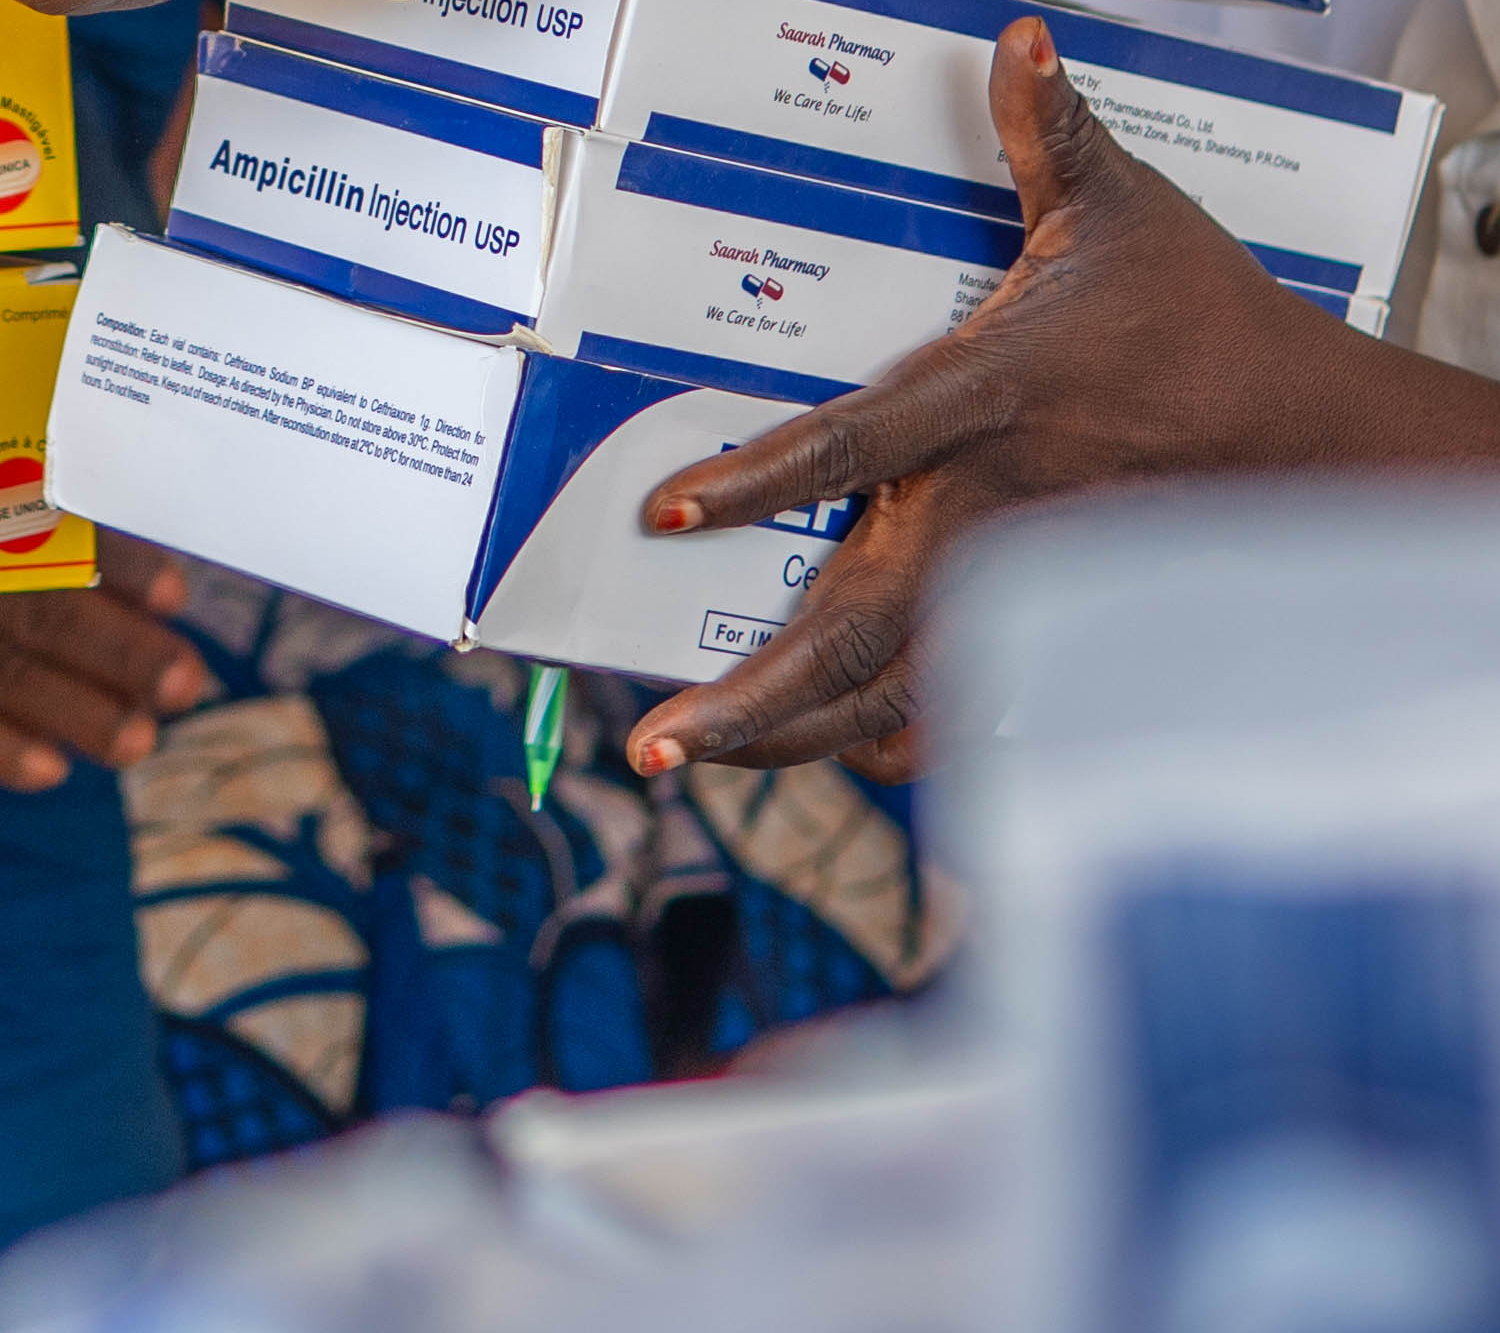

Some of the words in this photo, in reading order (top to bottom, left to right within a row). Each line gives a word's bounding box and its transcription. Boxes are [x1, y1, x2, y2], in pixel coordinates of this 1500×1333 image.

[536, 3, 584, 40] USP
[776, 22, 826, 49] Saarah
[827, 33, 895, 66] Pharmacy
[773, 88, 791, 106] We
[794, 93, 822, 112] Care
[823, 98, 844, 116] for
[845, 103, 872, 122] Life!
[1102, 98, 1175, 125] Pharmaceutical
[0, 96, 56, 161] Mastigável
[209, 139, 365, 213] Ampicillin
[368, 183, 467, 243] Injection
[475, 220, 520, 257] USP
[709, 240, 759, 265] Saarah
[761, 250, 831, 281] Pharmacy
[706, 306, 724, 323] We
[727, 309, 756, 328] Care
[756, 315, 777, 333] for
[779, 319, 807, 339] Life!
[95, 313, 146, 338] Composition:
[148, 329, 169, 345] Each
[171, 340, 185, 351] vial
[187, 344, 221, 362] contains:
[223, 353, 266, 377] Ceftriaxone
[268, 367, 298, 386] Sodium
[300, 377, 315, 390] BP
[316, 385, 356, 405] equivalent
[358, 396, 367, 408] to
[370, 399, 415, 424] Ceftriaxone
[419, 414, 431, 431] 1g.
[434, 419, 471, 441] Direction
[473, 431, 486, 445] for
[103, 378, 115, 394] Do
[114, 384, 128, 398] not
[84, 354, 113, 372] sunlight
[112, 361, 127, 376] and
[128, 368, 159, 386] moisture.
[160, 376, 180, 395] Keep
[180, 385, 193, 398] out
[192, 386, 201, 399] of
[200, 388, 222, 406] reach
[222, 397, 231, 410] of
[230, 397, 260, 419] children.
[261, 408, 280, 424] After
[279, 416, 330, 441] reconstitution
[331, 432, 350, 449] store
[350, 439, 359, 452] at
[373, 442, 381, 458] to
[397, 450, 409, 466] for
[408, 457, 423, 472] not
[422, 460, 443, 477] more
[442, 467, 461, 483] than
[461, 472, 473, 486] 24
[140, 347, 160, 364] Refer
[160, 355, 169, 368] to
[197, 366, 228, 388] Dosage:
[229, 376, 239, 390] As
[239, 381, 271, 400] directed
[271, 389, 282, 406] by
[282, 394, 294, 408] the
[294, 397, 333, 420] Physician.
[334, 409, 346, 424] Do
[347, 417, 361, 429] not
[360, 417, 381, 435] store
[381, 426, 405, 443] above
[430, 440, 459, 461] Protect
[459, 449, 479, 466] from
[715, 623, 744, 643] For
